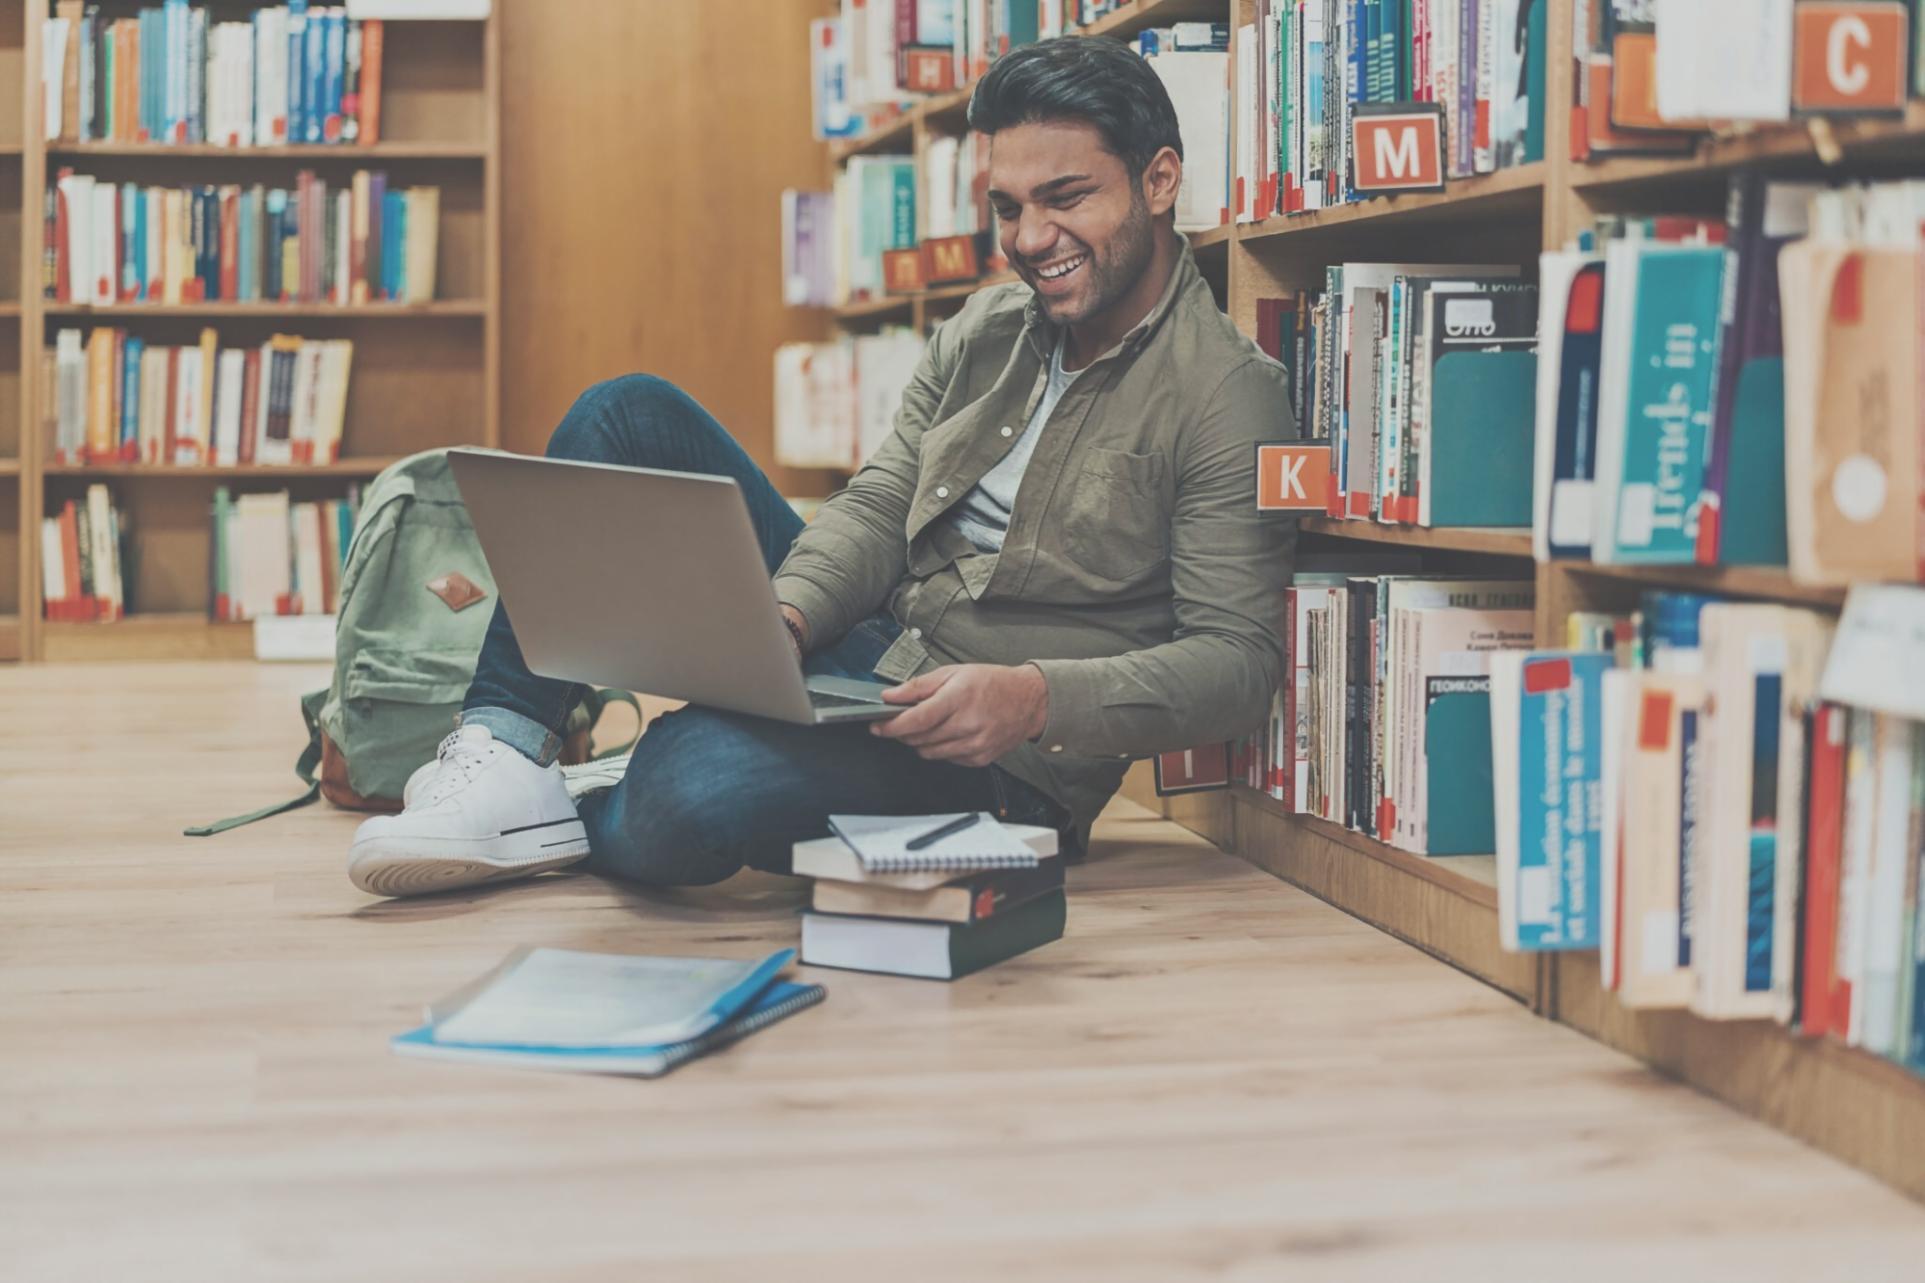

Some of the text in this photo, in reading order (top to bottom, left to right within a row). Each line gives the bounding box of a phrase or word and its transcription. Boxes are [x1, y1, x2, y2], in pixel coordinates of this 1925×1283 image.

[1827, 14, 1872, 96] C
[1374, 126, 1421, 180] M
[1644, 323, 1697, 529] Trends in
[1280, 455, 1307, 500] K
